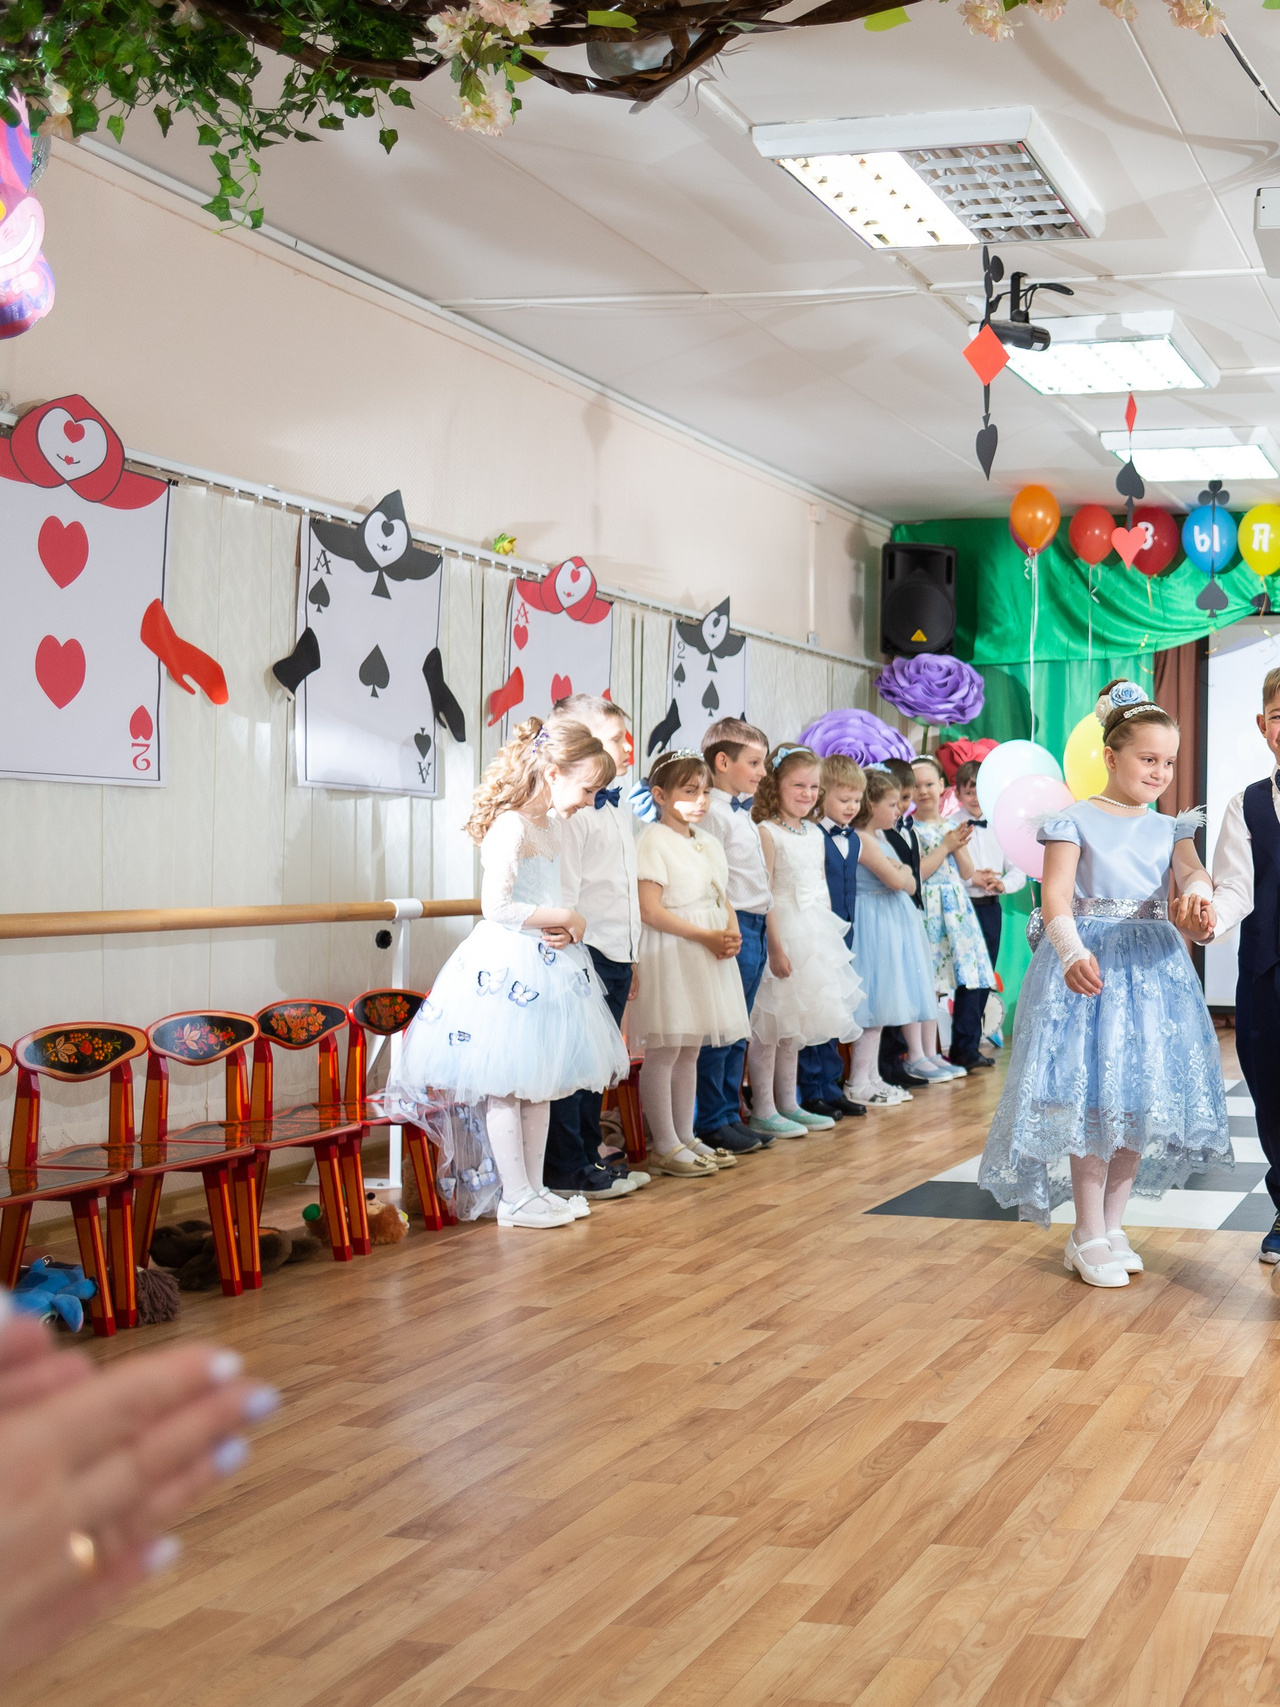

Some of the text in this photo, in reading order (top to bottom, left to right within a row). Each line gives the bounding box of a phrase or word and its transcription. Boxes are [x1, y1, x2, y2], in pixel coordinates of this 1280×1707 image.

[313, 549, 333, 575] A
[514, 602, 530, 624] A
[676, 640, 687, 659] 2
[131, 742, 151, 771] 2
